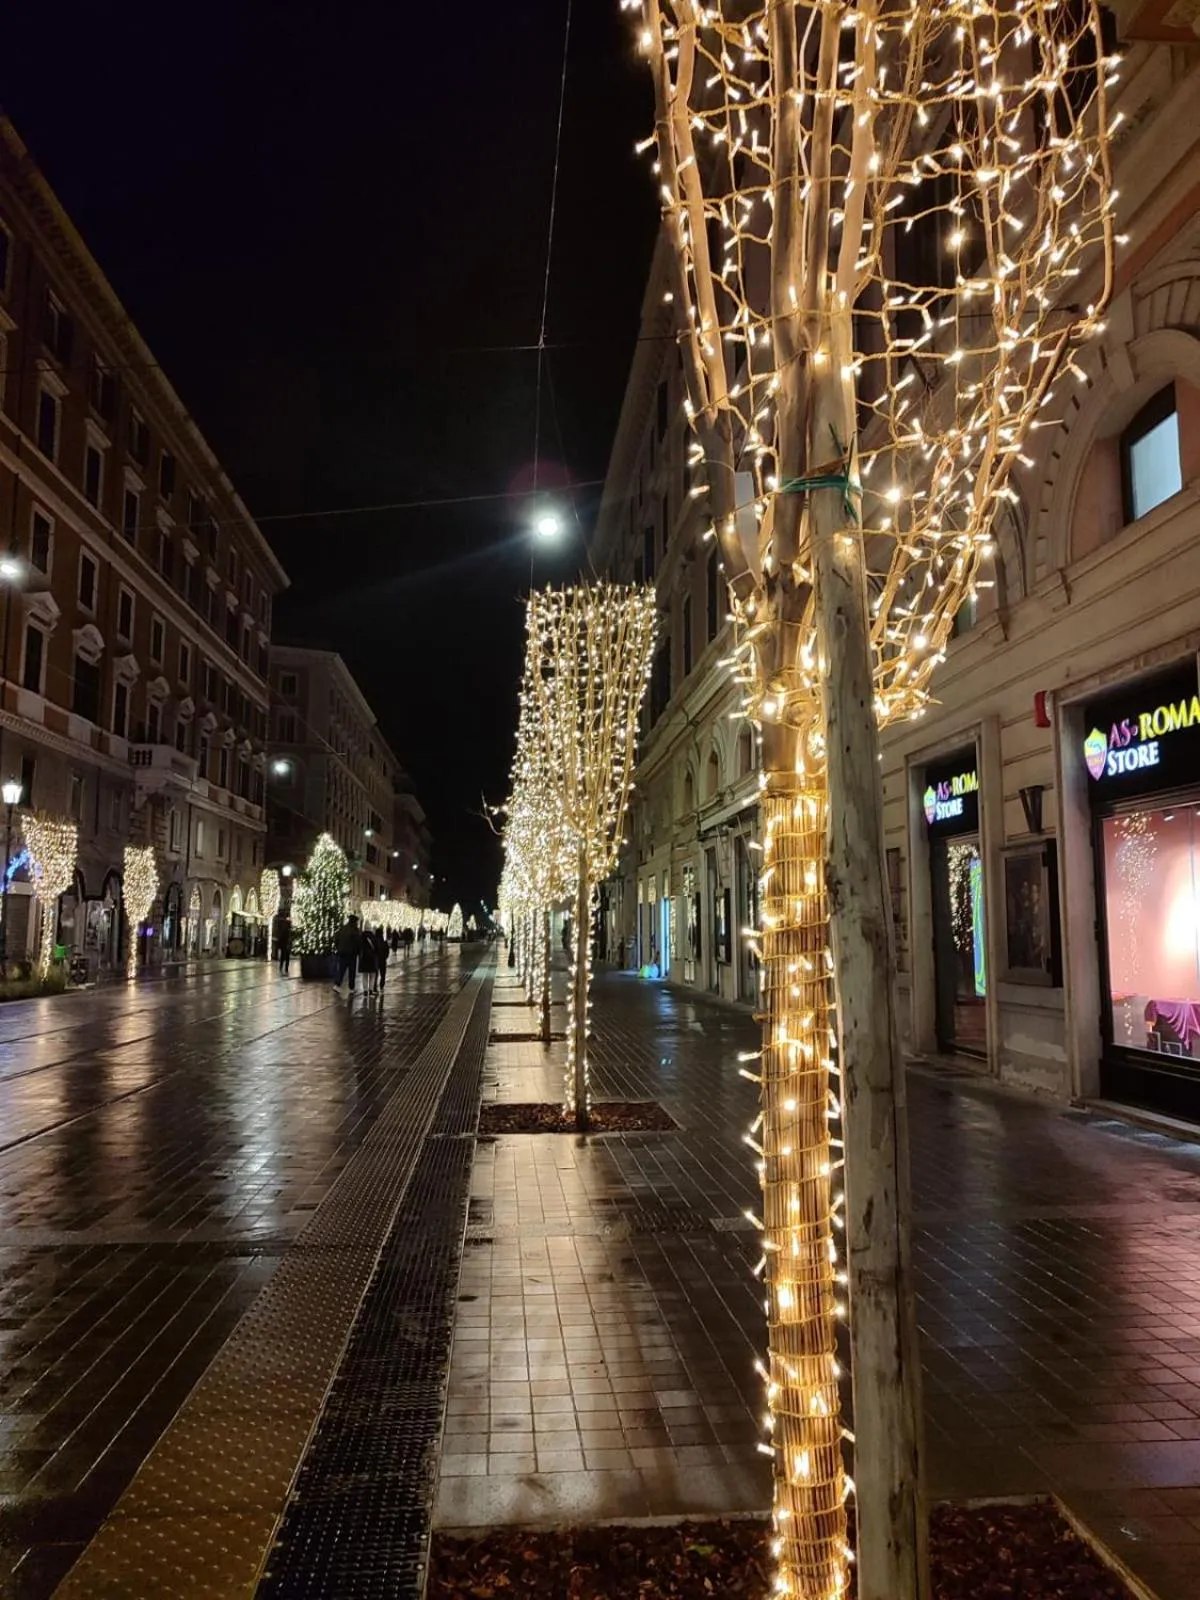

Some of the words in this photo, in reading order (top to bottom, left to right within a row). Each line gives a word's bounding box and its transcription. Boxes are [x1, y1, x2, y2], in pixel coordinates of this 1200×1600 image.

[1138, 695, 1200, 741] ROMA
[1107, 741, 1160, 776] STORE
[936, 797, 963, 821] STORE
